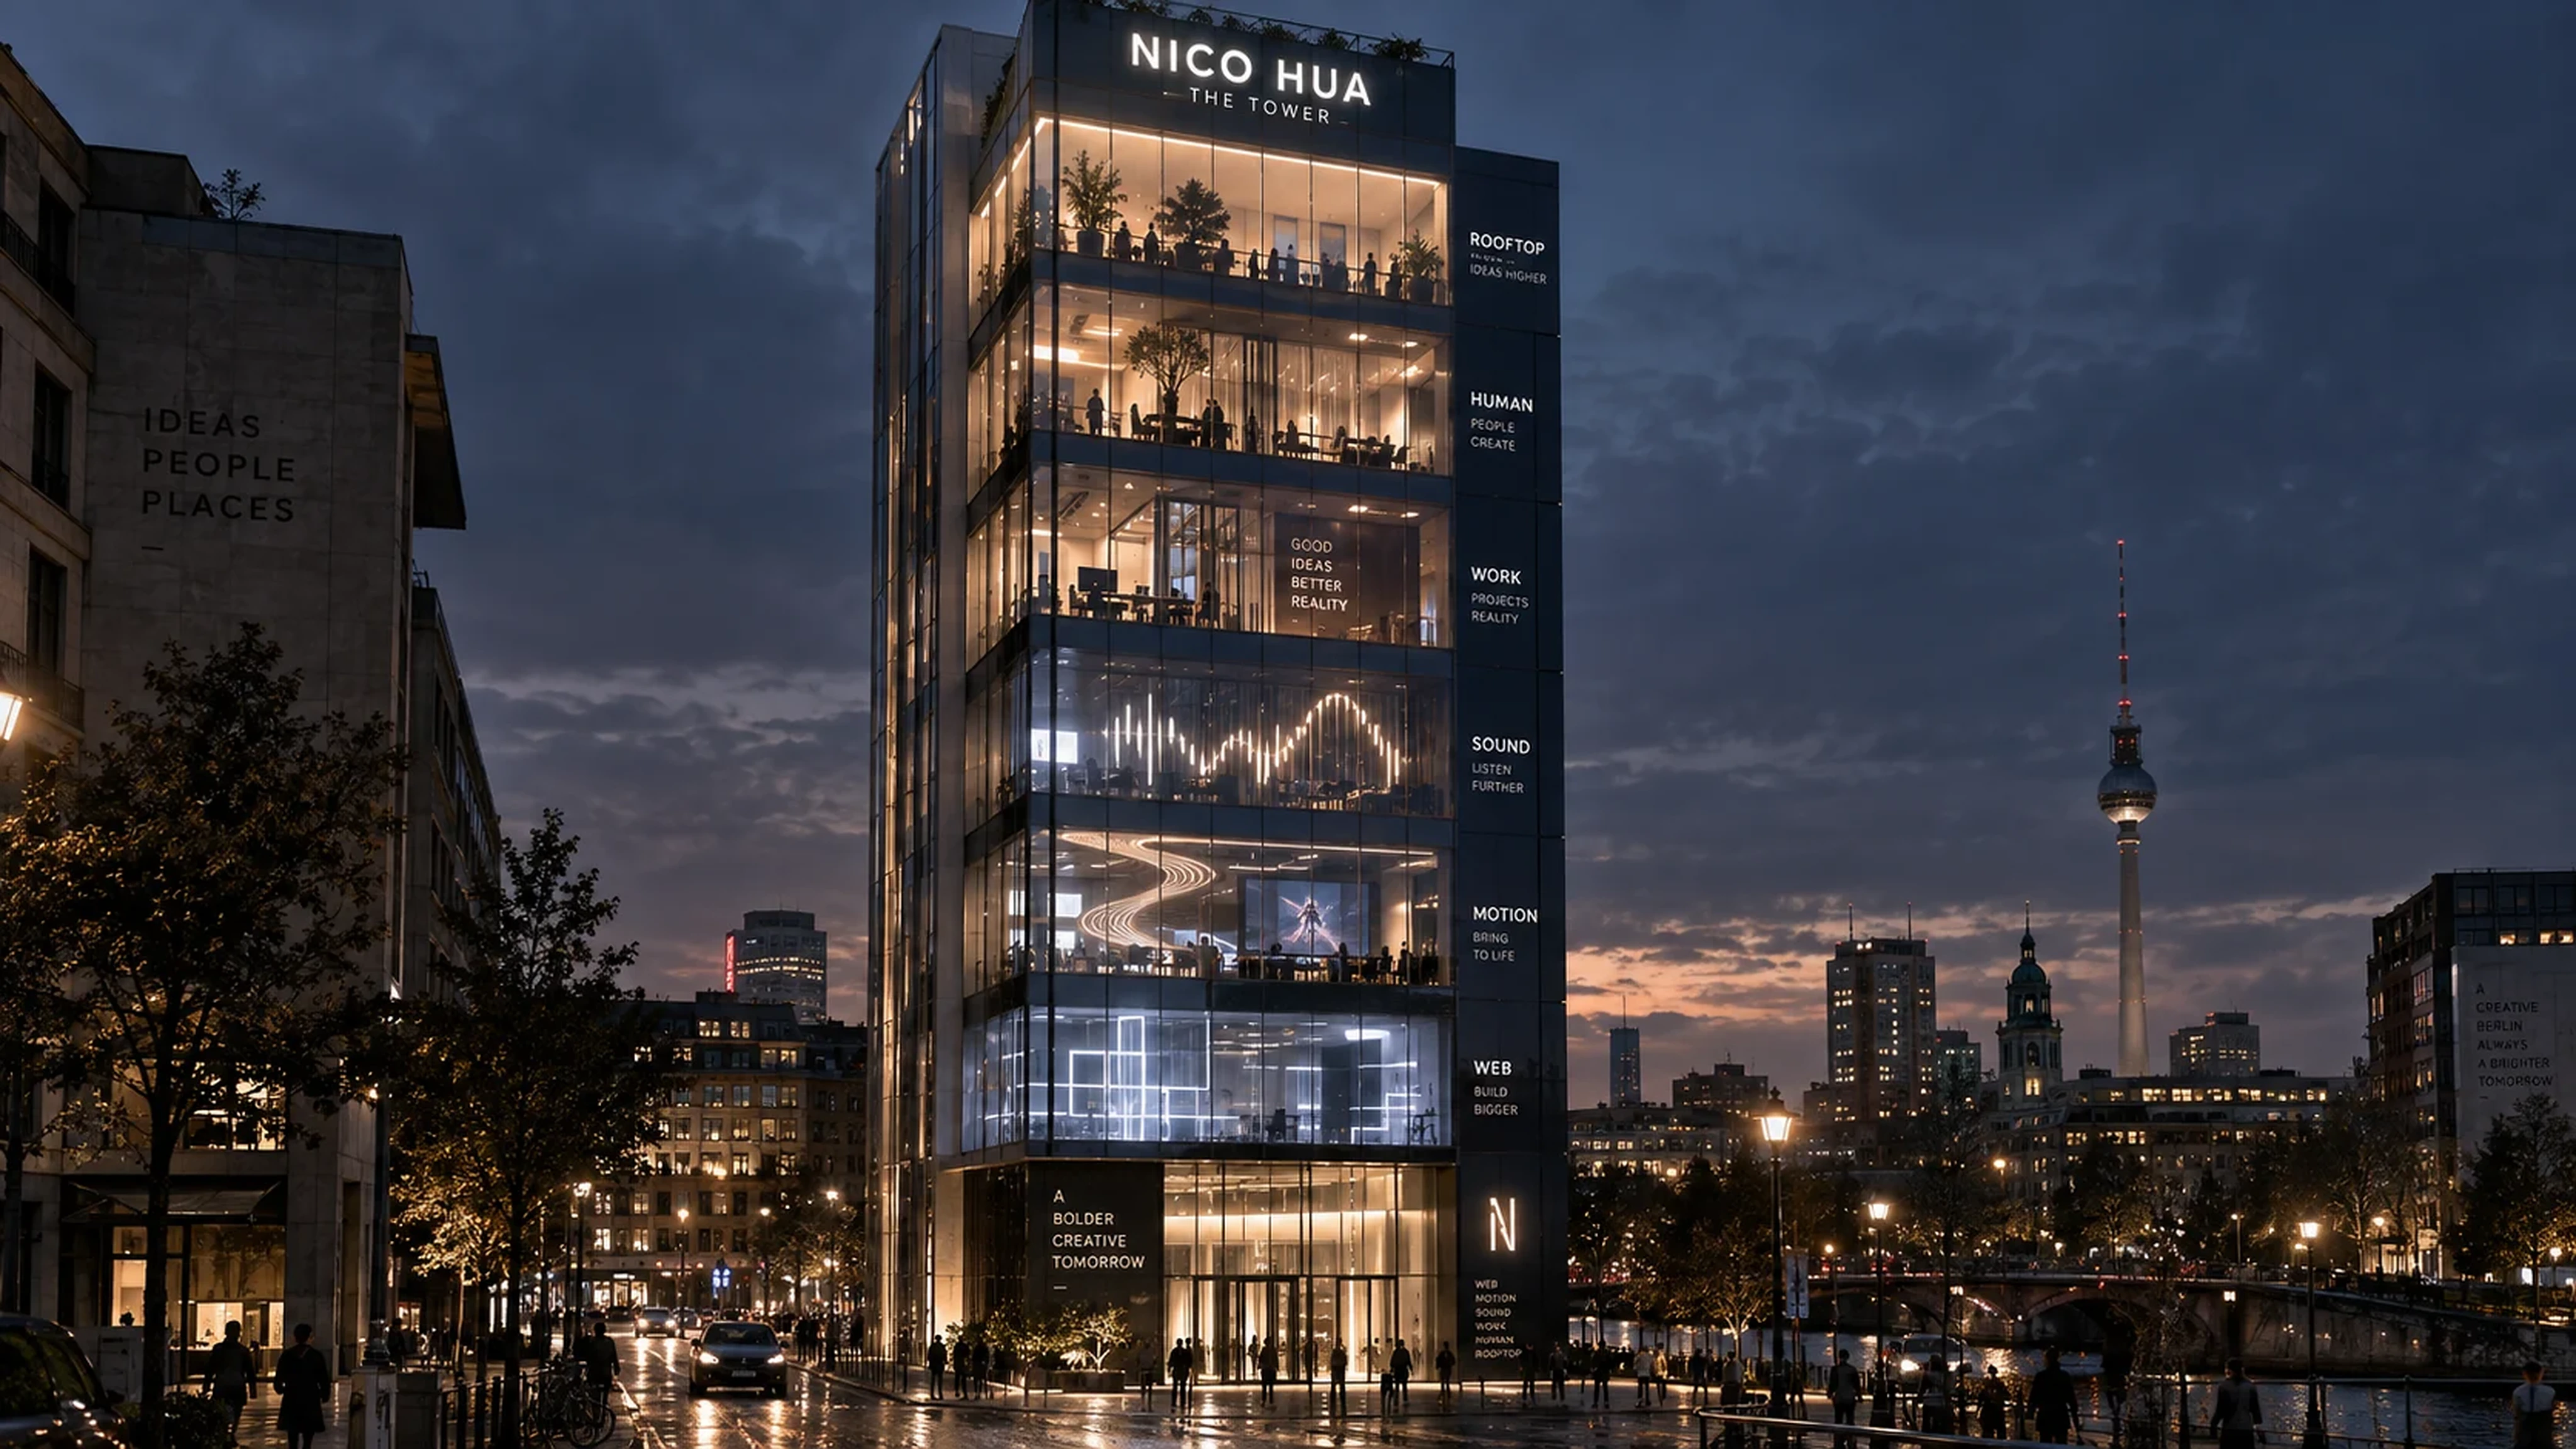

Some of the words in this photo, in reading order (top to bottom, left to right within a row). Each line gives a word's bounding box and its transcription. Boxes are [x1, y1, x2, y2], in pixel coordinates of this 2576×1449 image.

[1131, 32, 1253, 84] NICO
[1277, 58, 1371, 106] HUA
[1189, 87, 1234, 109] THE
[1248, 96, 1330, 125] TOWER
[1470, 231, 1545, 255] ROOFTOP
[1469, 264, 1503, 278] IDEAS
[1506, 270, 1547, 284] HIGHER
[1470, 391, 1533, 413] HUMAN
[145, 406, 260, 439] IDEAS
[1470, 418, 1515, 433] PEOPLE
[1470, 436, 1516, 452] CREATE
[143, 448, 295, 482] PEOPLE
[142, 490, 294, 523] PLACES
[1291, 537, 1333, 553] GOOD
[1291, 557, 1333, 573] IDEAS
[1470, 566, 1521, 585] WORK
[1291, 575, 1342, 592] BETTER
[1291, 595, 1348, 612] REALITY
[1471, 592, 1530, 609] PROJECTS
[1471, 610, 1519, 625] REALITY
[1472, 735, 1531, 755] SOUND
[1472, 762, 1513, 775] LISTEN
[1472, 780, 1524, 794] FURTHER
[1473, 906, 1538, 923] MOTION
[1473, 931, 1509, 944] BRING
[1473, 949, 1489, 961] TO
[1491, 950, 1515, 962] LIFE
[2475, 983, 2485, 994] A
[2476, 1002, 2539, 1013] CREATIVE
[2476, 1020, 2523, 1032] BERLIN
[2477, 1040, 2528, 1050] ALWAYS
[1474, 1060, 1513, 1075] WEB
[2478, 1058, 2486, 1068] A
[2490, 1057, 2550, 1069] BRIGHTER
[2478, 1075, 2554, 1087] TOMORROW
[1474, 1085, 1508, 1097] BUILD
[1474, 1104, 1518, 1116] BIGGER
[1053, 1189, 1065, 1203] A
[1053, 1211, 1114, 1226] BOLDER
[1489, 1197, 1515, 1251] N
[1052, 1234, 1127, 1248] CREATIVE
[1052, 1255, 1145, 1269] TOMORROW
